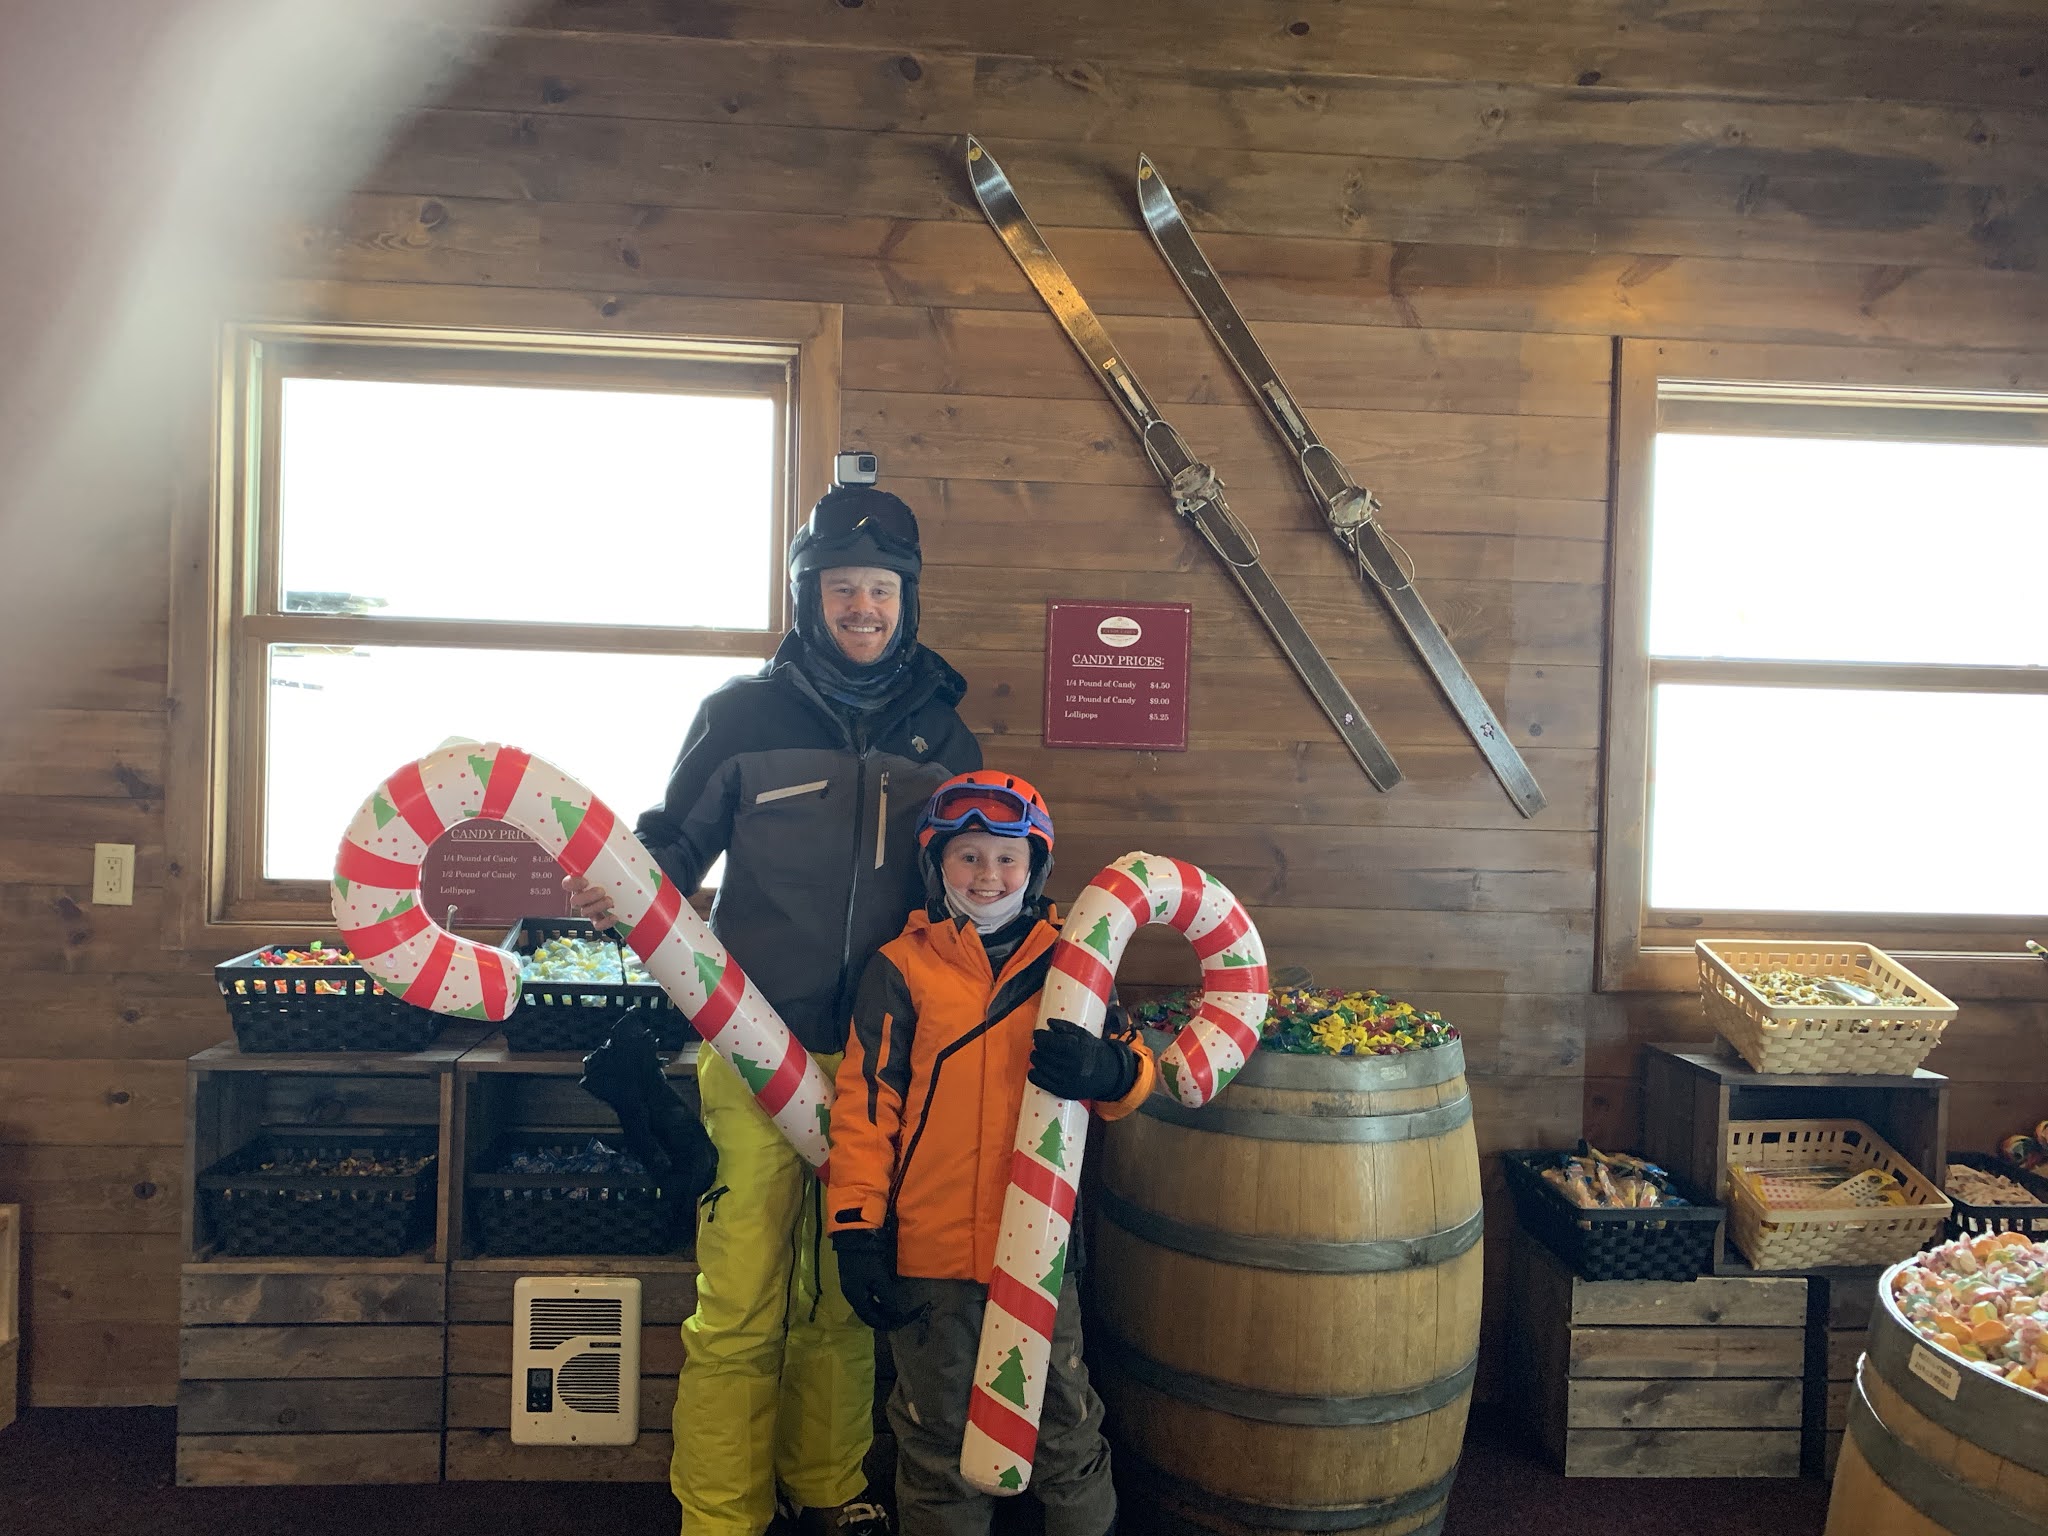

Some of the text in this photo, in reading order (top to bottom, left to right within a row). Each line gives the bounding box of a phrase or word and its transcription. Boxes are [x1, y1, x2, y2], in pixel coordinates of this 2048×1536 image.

[1072, 653, 1165, 667] CANDY PRICES:
[1079, 680, 1102, 688] Pound
[1103, 680, 1112, 688] of
[1112, 681, 1137, 690] Candy
[1149, 682, 1171, 690] $4.50
[1065, 695, 1170, 706] 1/2 Pound of Candy $9.00
[1064, 710, 1170, 721] Lollipops $5.25
[451, 829, 535, 840] CANDY PRIC
[443, 854, 455, 862] 1/4
[457, 854, 482, 863] Pound
[492, 855, 518, 864] Candy
[455, 871, 480, 879] Pound
[491, 871, 517, 880] Candy
[440, 886, 552, 896] Lollipops $5.25
